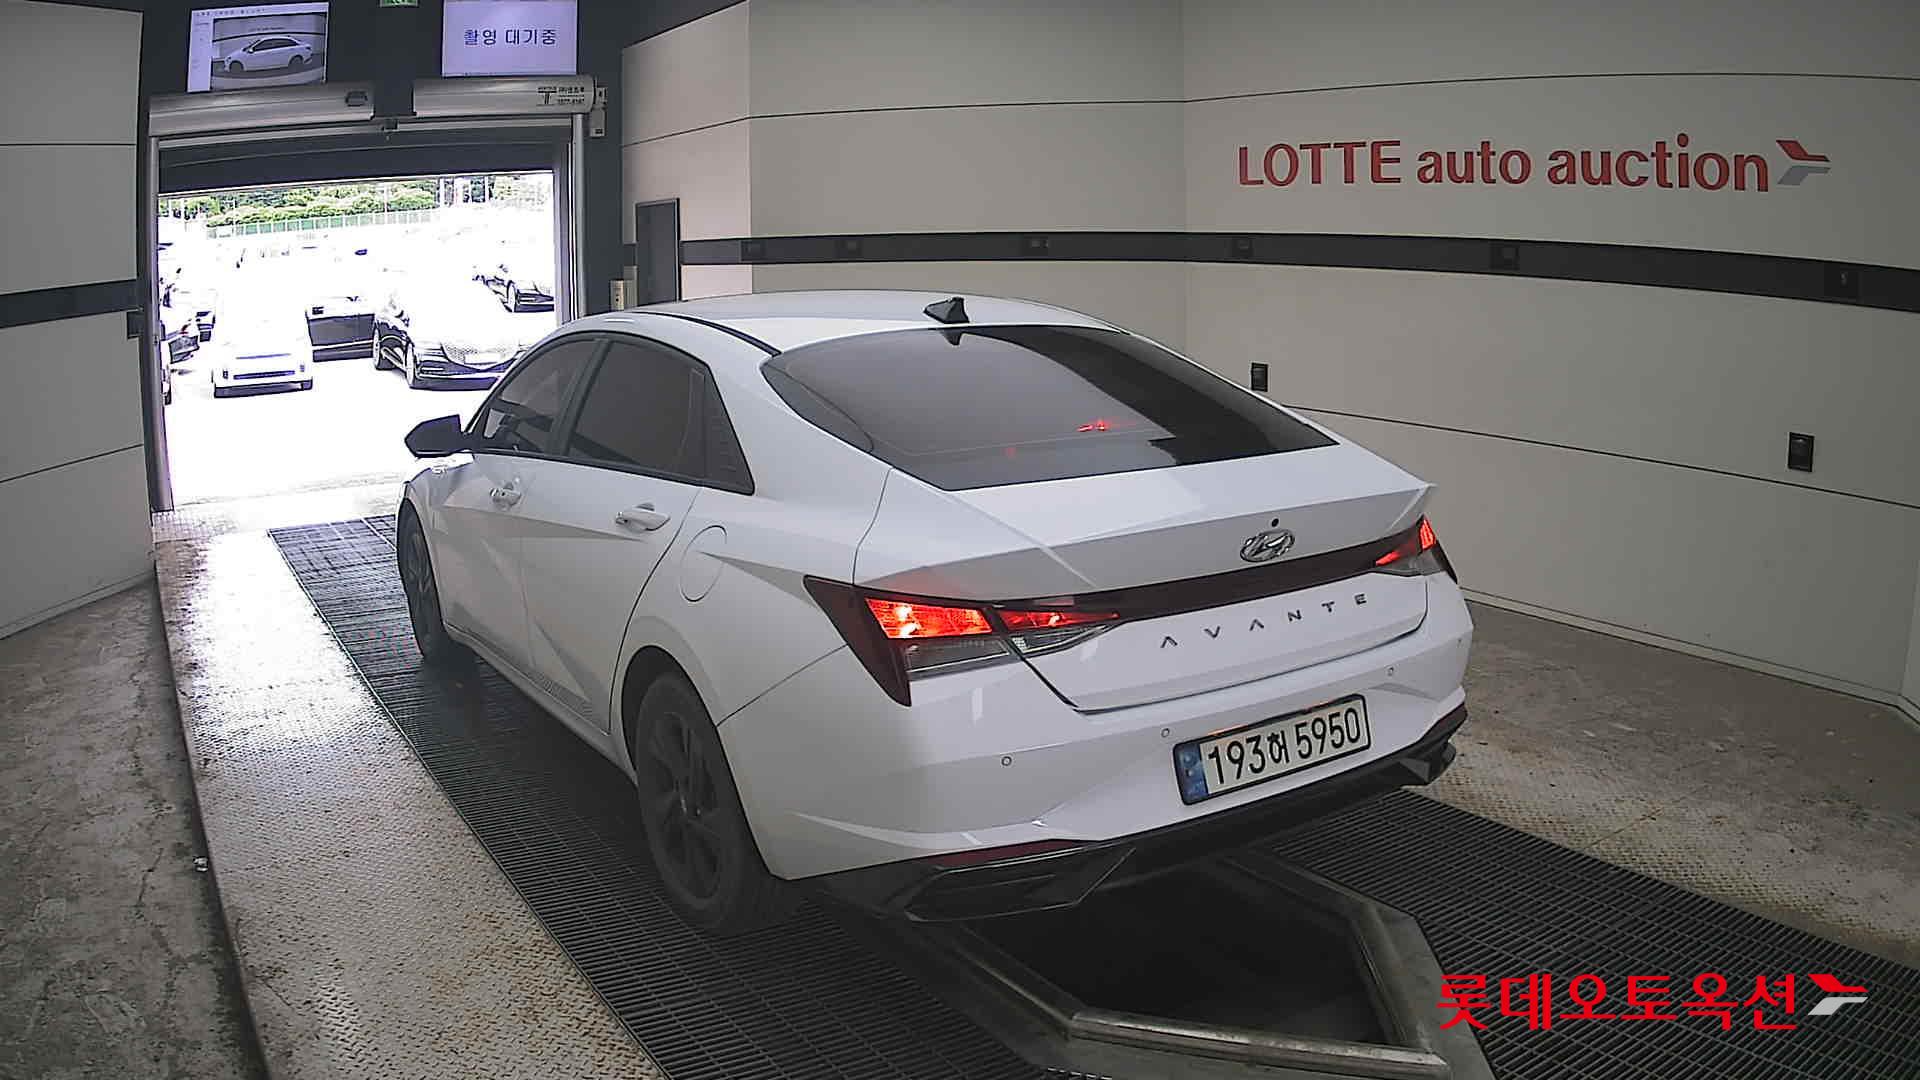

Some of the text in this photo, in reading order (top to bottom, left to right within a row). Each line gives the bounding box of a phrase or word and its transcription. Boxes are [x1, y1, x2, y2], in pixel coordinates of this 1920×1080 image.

[505, 29, 556, 45] 대기중
[1238, 134, 1769, 192] LOTTE auto auction
[1161, 593, 1367, 649] AVANTE
[1295, 707, 1361, 760] 5950
